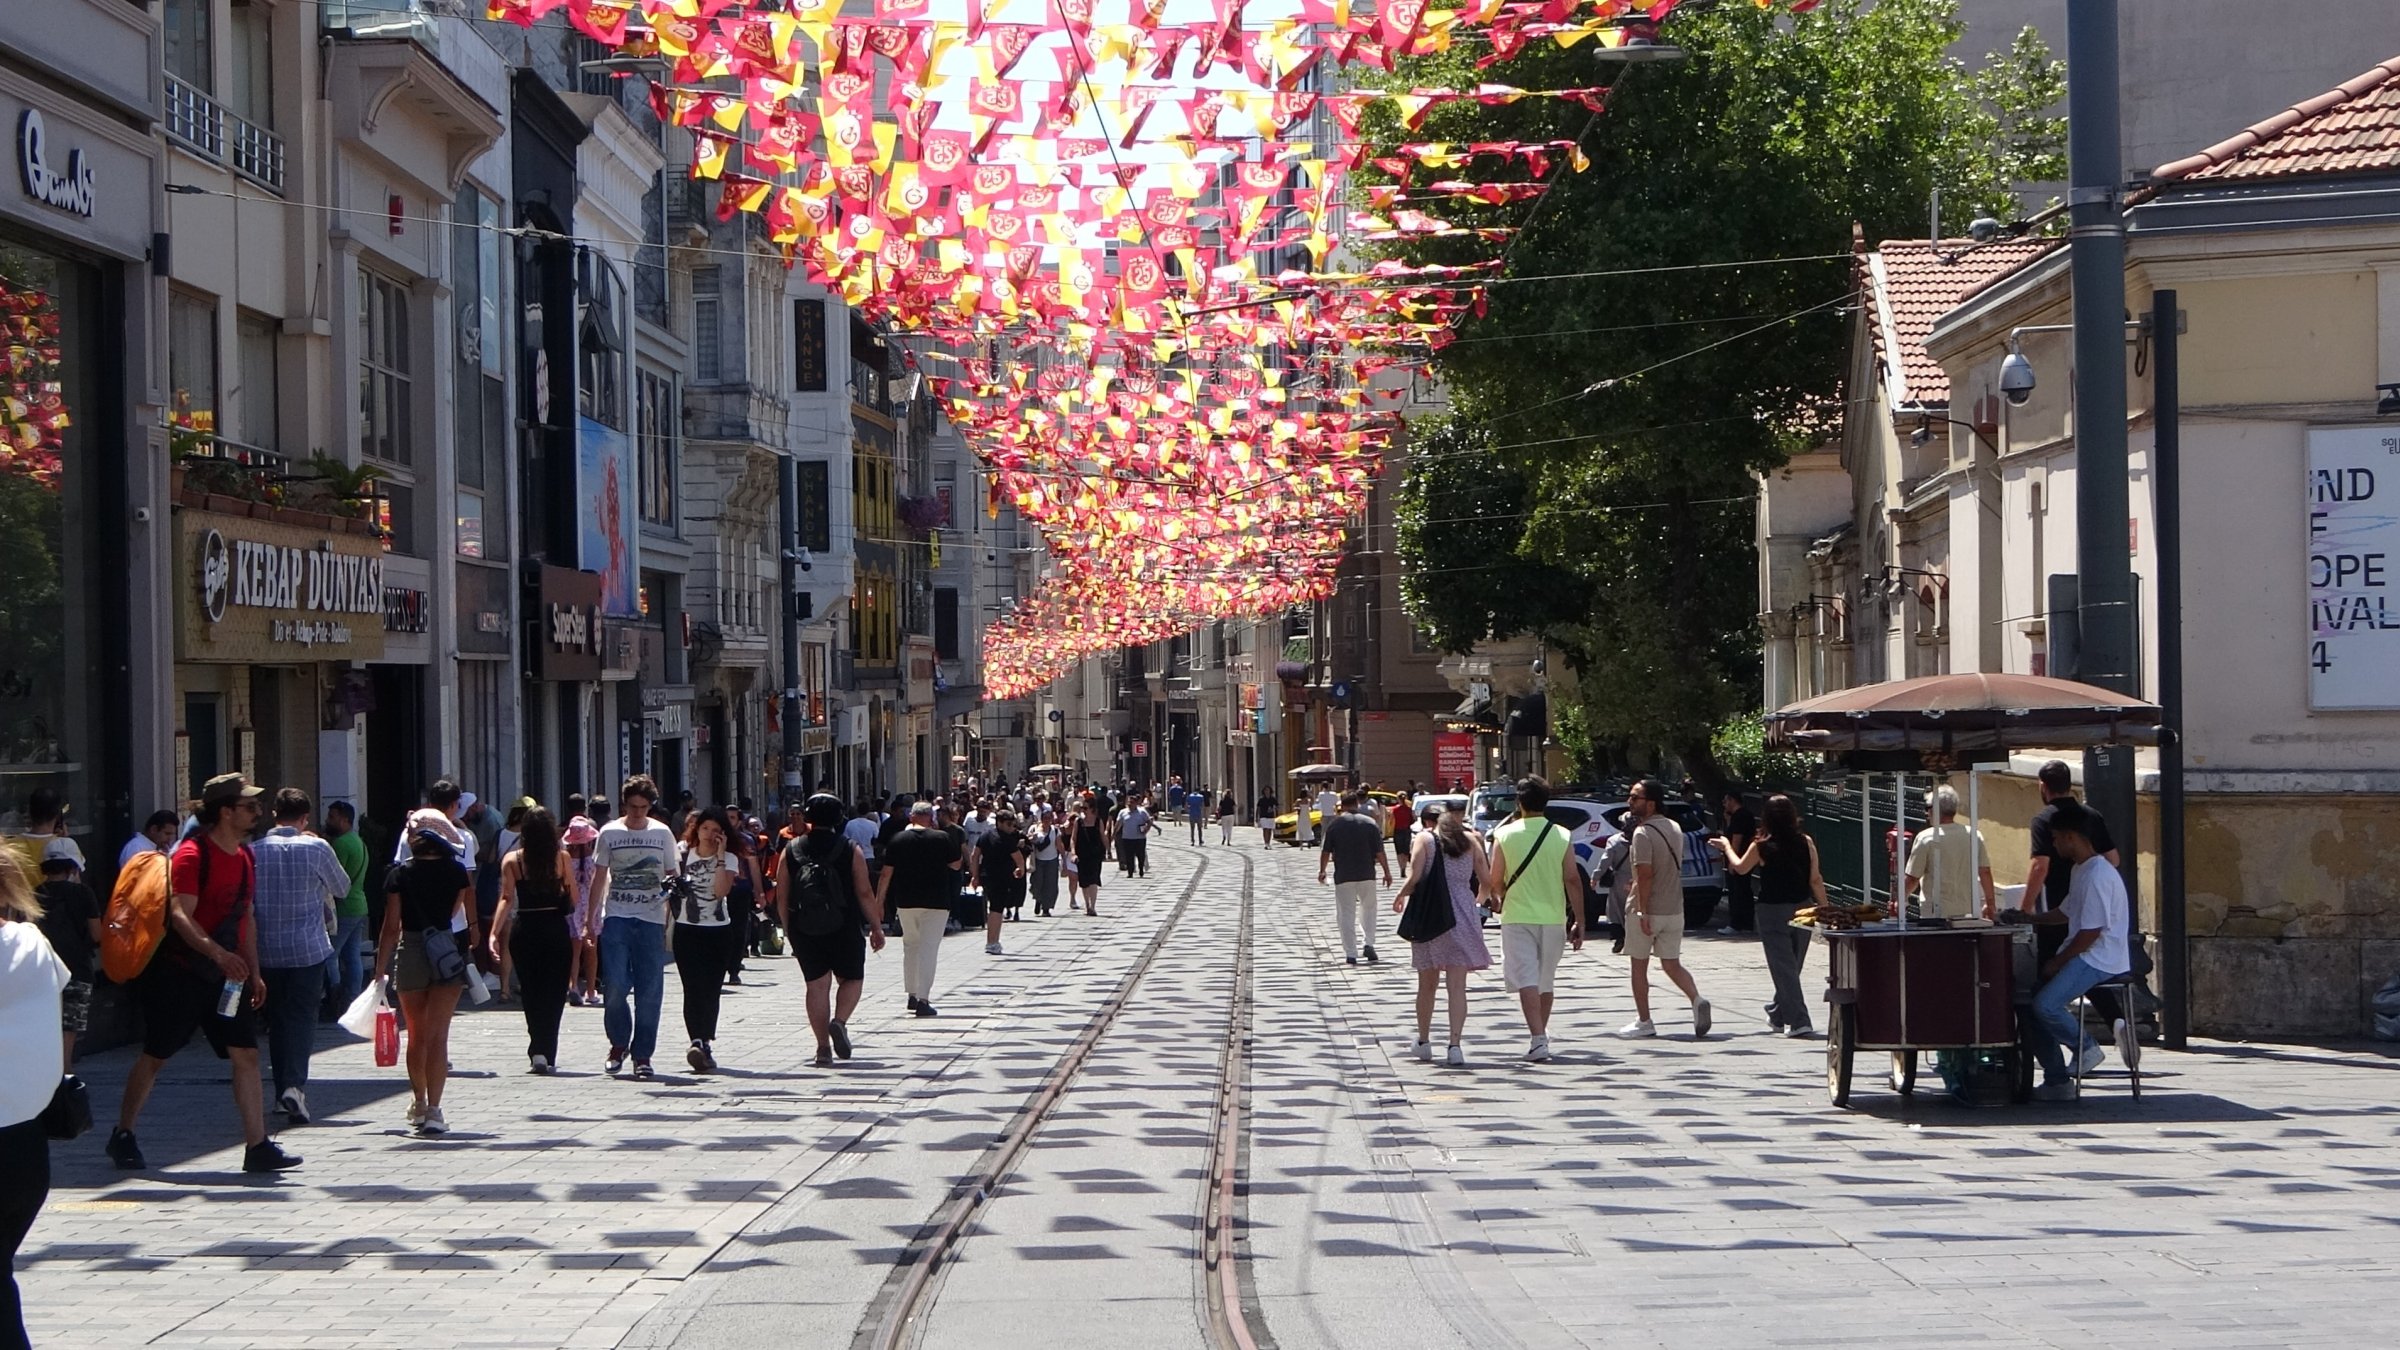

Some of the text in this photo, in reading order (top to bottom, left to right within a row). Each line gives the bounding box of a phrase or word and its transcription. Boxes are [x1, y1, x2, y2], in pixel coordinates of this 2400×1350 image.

[22, 108, 96, 217] Bambi
[1135, 267, 1151, 286] 25
[802, 304, 813, 384] CHANGE
[2309, 467, 2375, 502] ND
[235, 540, 303, 609] KEBAP
[308, 540, 384, 613] DÜNYASI
